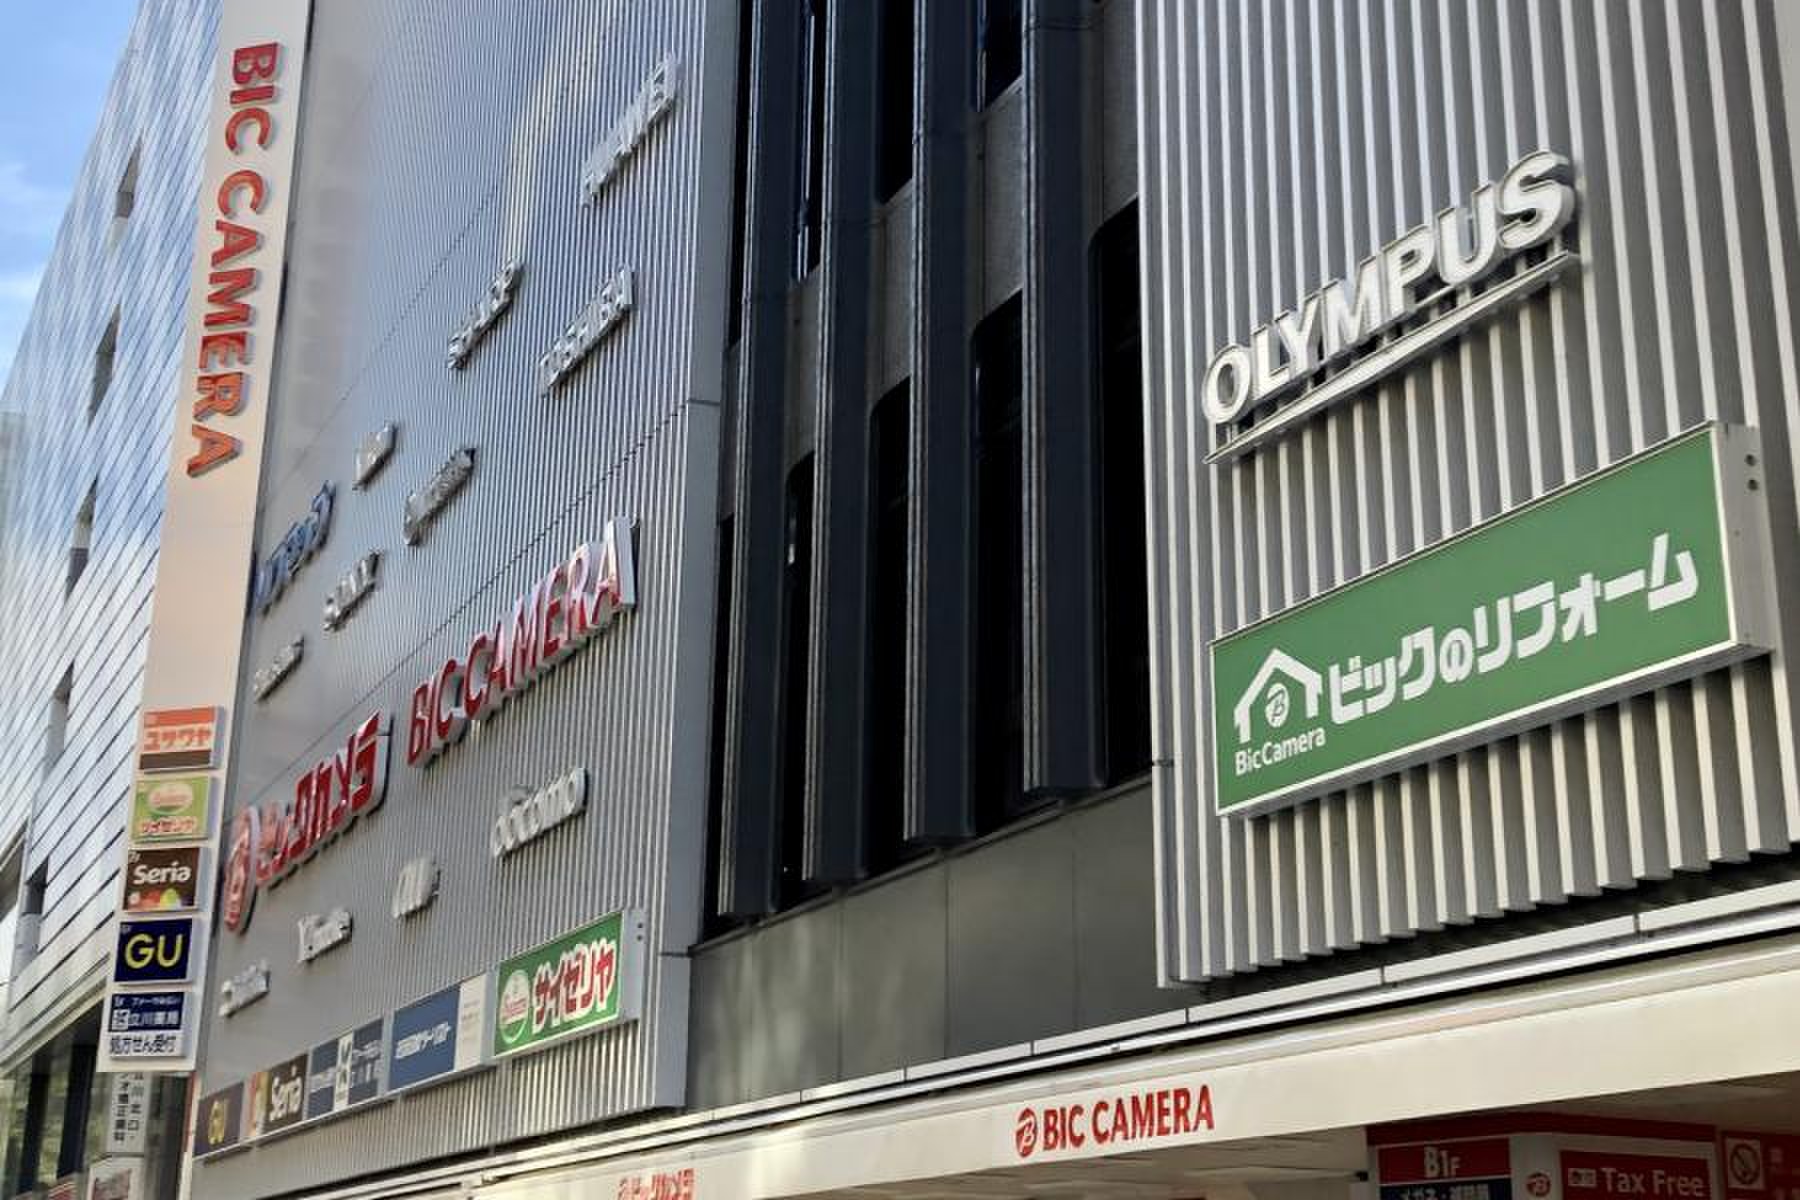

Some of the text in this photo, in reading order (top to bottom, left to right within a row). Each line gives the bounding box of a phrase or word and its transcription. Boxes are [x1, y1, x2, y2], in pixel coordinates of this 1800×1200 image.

[186, 42, 280, 478] BIC CAMERA
[1202, 148, 1578, 425] OLYMPUS
[408, 657, 466, 766] BIC
[464, 516, 636, 721] CAMERA
[1328, 531, 1699, 727] ビックのリフォーム
[1234, 726, 1327, 776] BicCamera
[133, 861, 191, 886] Seria
[125, 933, 184, 969] GU
[532, 938, 617, 1035] サイゼリヤ
[1043, 1105, 1086, 1151] BIC
[1091, 1084, 1215, 1145] CAMERA
[1602, 1167, 1705, 1198] Tax Free
